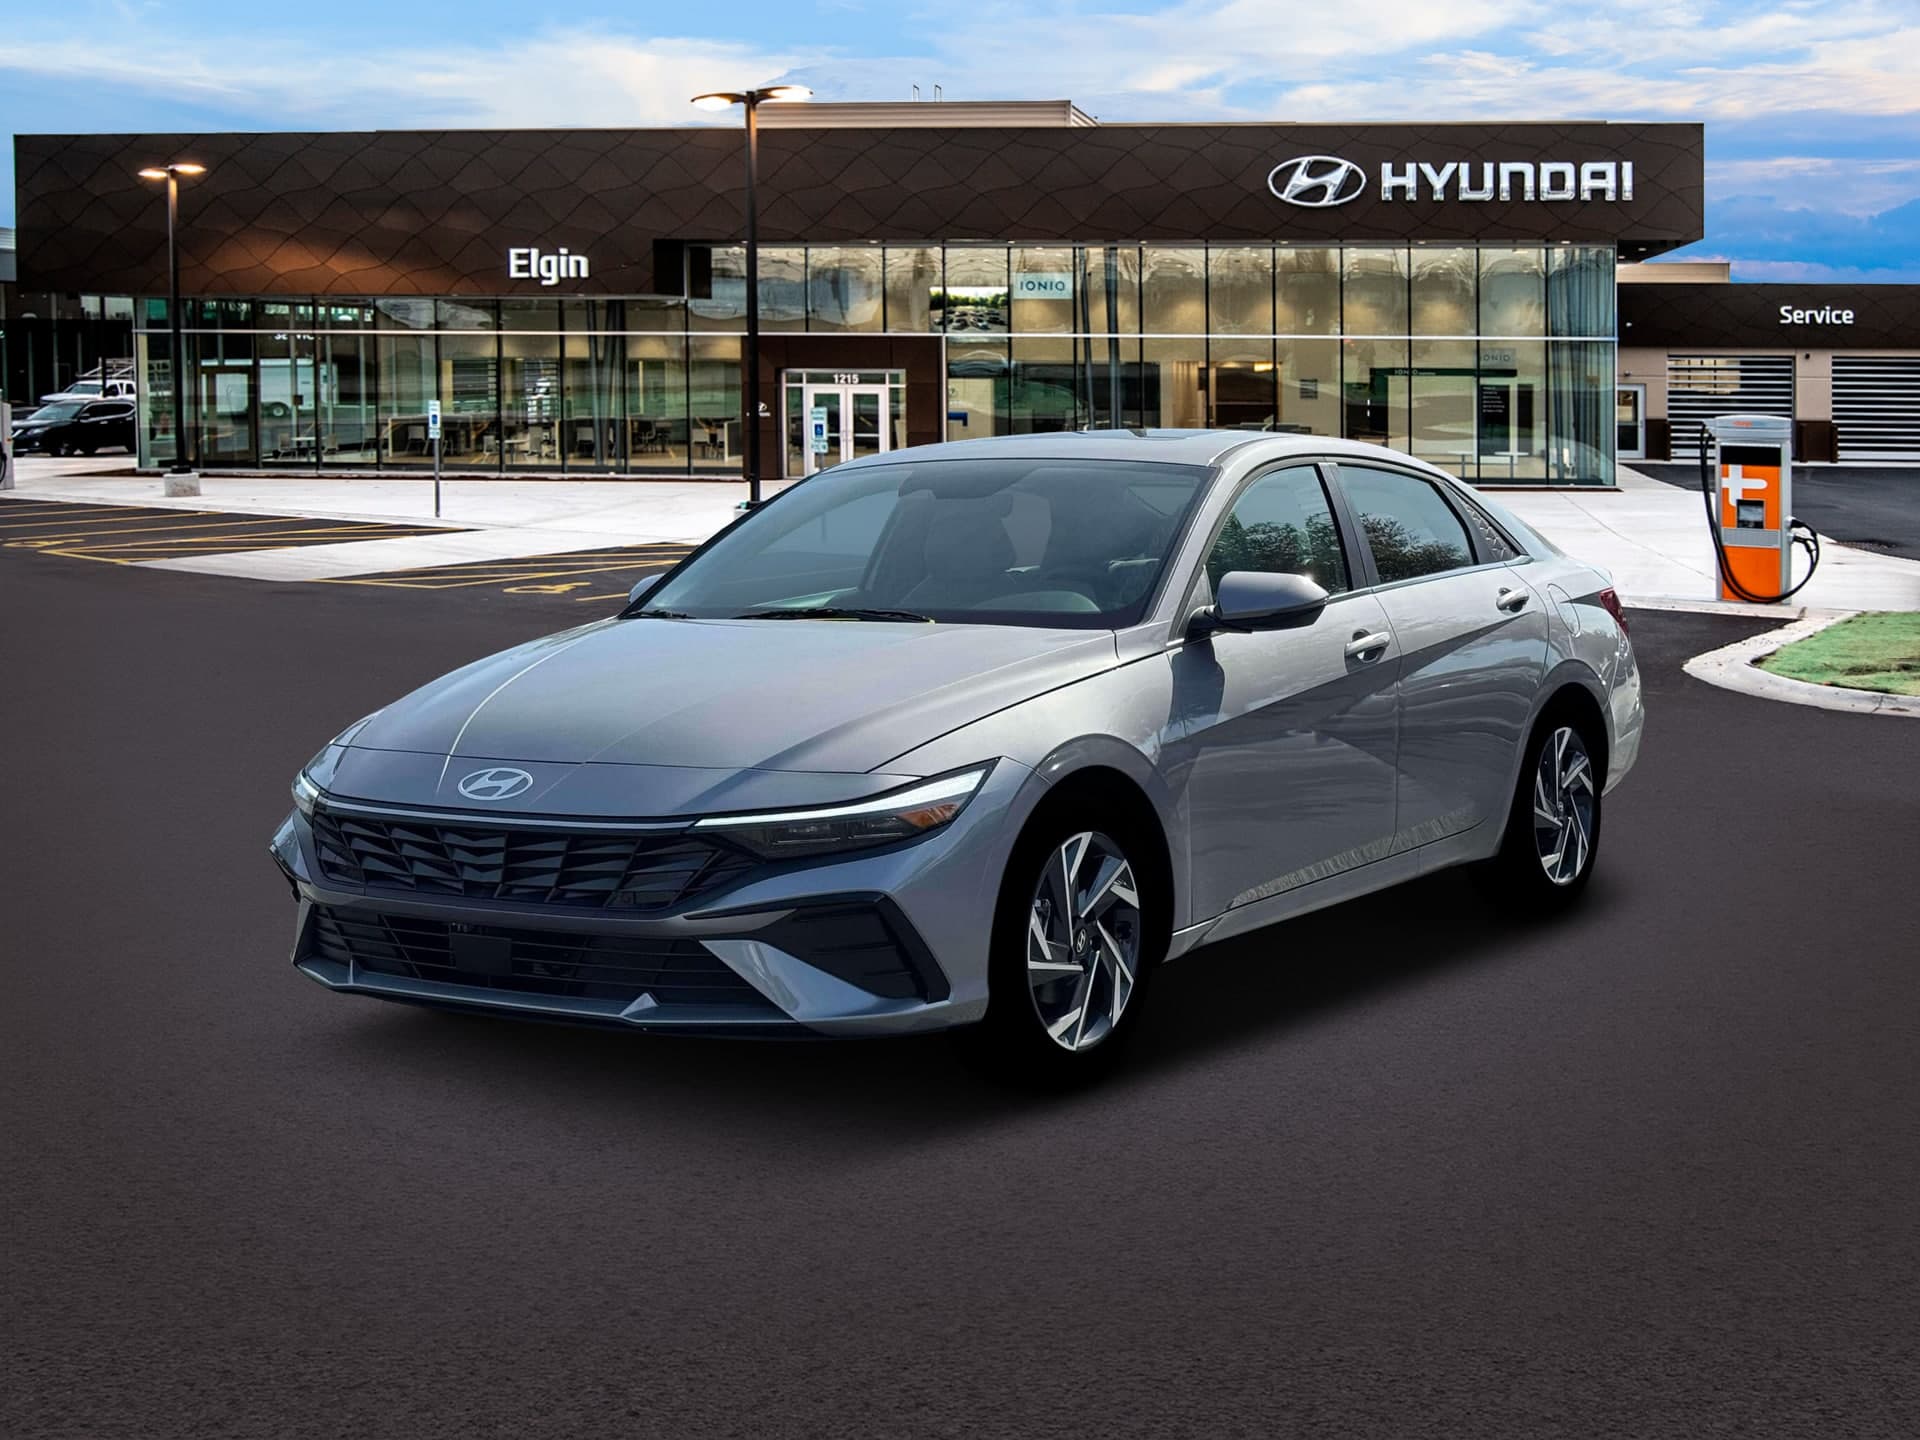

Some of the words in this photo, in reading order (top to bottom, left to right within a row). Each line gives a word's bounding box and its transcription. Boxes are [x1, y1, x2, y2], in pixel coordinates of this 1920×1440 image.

[1381, 161, 1633, 202] HYUNDAI
[508, 247, 590, 286] Elgin
[1779, 305, 1854, 325] Service
[833, 373, 860, 384] 1215
